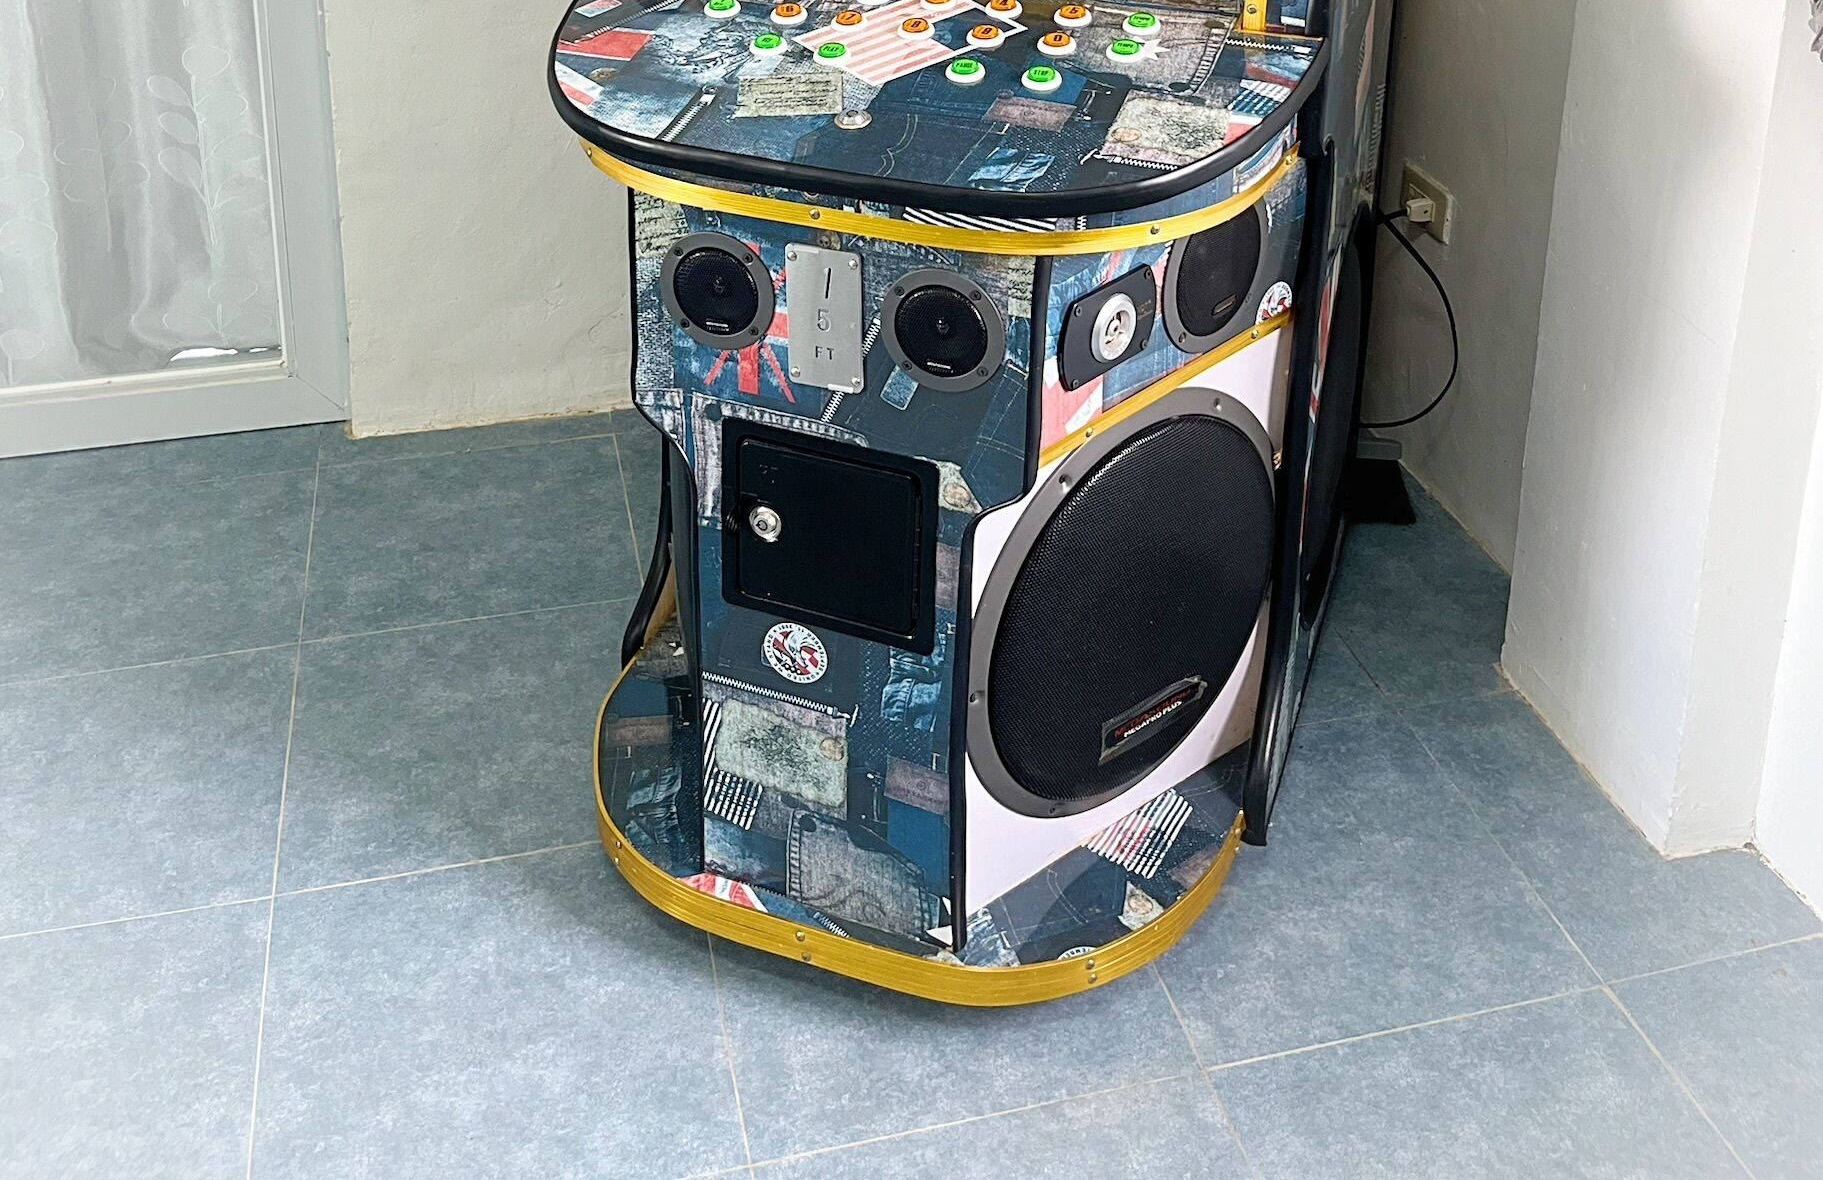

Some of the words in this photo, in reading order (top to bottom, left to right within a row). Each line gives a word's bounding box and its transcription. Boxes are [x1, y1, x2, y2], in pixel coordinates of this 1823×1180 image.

[1033, 69, 1050, 77] STOP
[816, 308, 832, 333] 5
[1161, 700, 1183, 716] PLUS
